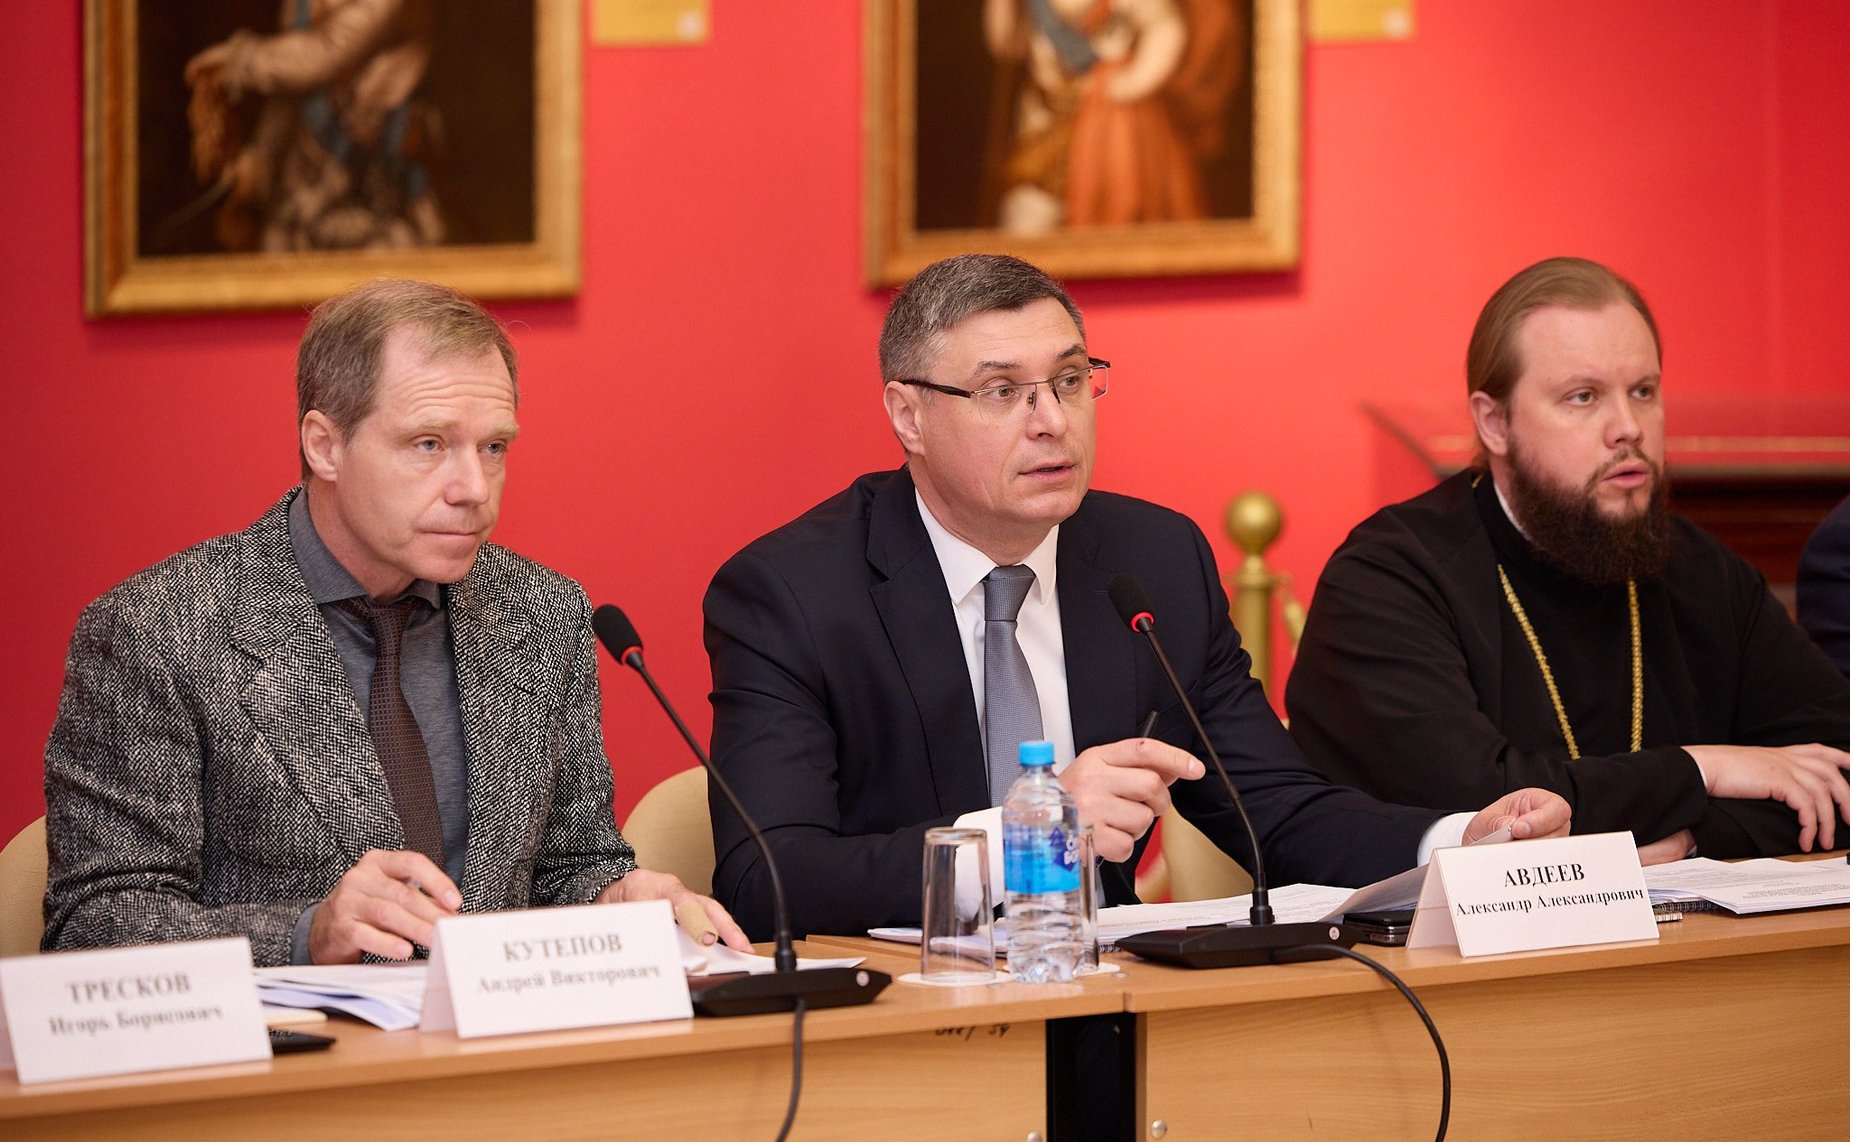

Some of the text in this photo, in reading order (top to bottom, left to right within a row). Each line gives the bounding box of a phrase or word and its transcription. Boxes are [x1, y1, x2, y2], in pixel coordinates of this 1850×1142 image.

[1503, 863, 1585, 887] АВДЕЕВ
[1457, 889, 1644, 915] Александр Александрович
[503, 934, 622, 961] КУТЕПОВ
[67, 973, 191, 1002] ТРЕСКОВ
[479, 965, 661, 995] Андрей Викторович
[49, 1005, 223, 1036] Игорь Борисович
